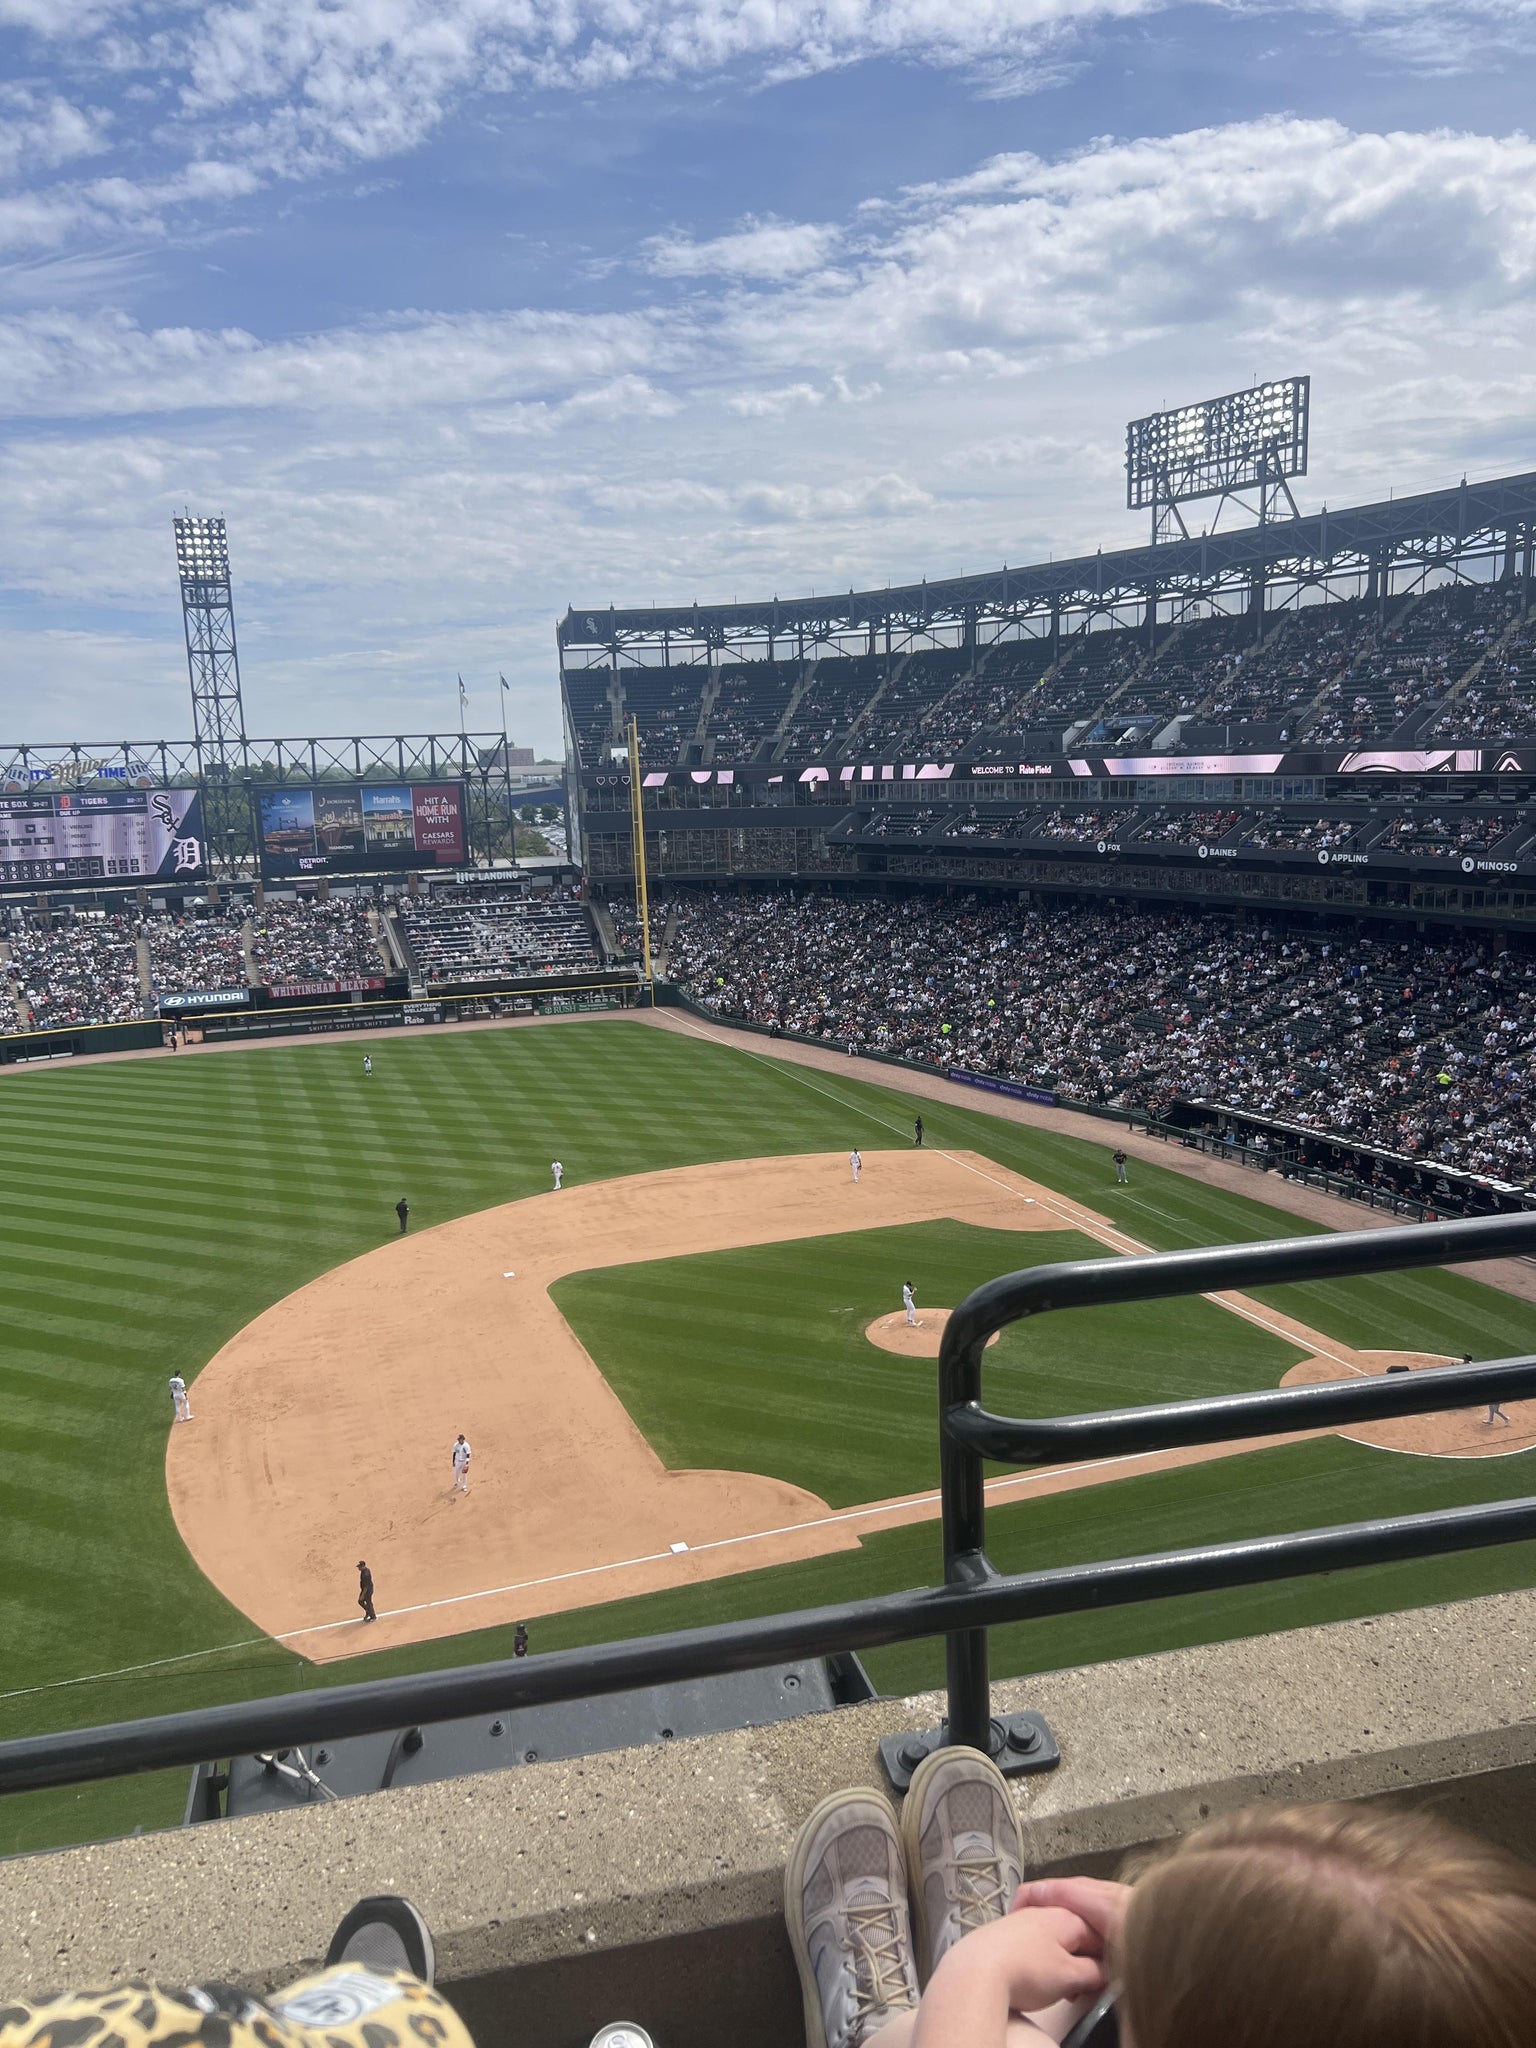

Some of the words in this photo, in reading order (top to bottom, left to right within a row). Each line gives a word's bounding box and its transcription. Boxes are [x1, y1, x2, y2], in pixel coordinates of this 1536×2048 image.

[30, 769, 52, 780] IT'S
[47, 758, 110, 785] Miller
[98, 767, 127, 778] TIME
[127, 764, 149, 779] Lite
[971, 766, 1004, 775] WELCOME
[1005, 766, 1015, 774] TO
[1019, 763, 1034, 775] Rate
[1035, 765, 1052, 774] Field
[8, 768, 29, 782] Lite
[80, 797, 108, 805] TIGERS
[424, 796, 439, 805] HIT
[441, 796, 448, 804] A
[416, 805, 439, 817] HOME
[440, 804, 458, 816] RUN
[425, 816, 450, 824] WITH
[422, 831, 455, 839] CAESARS
[1107, 843, 1121, 851] FOX
[1209, 848, 1237, 857] BAINES
[1331, 853, 1369, 863] APPLING
[1476, 861, 1518, 872] MINOSO
[456, 872, 475, 884] Lite
[478, 871, 518, 880] LANDING
[271, 982, 337, 998] WHITTINGHAM
[340, 979, 370, 992] MEATS
[188, 992, 244, 1004] HYUNDAI
[403, 1001, 442, 1009] EVERYTHING
[553, 1004, 576, 1014] RUSH
[404, 1016, 425, 1025] Rate
[1413, 1160, 1473, 1177] Field
